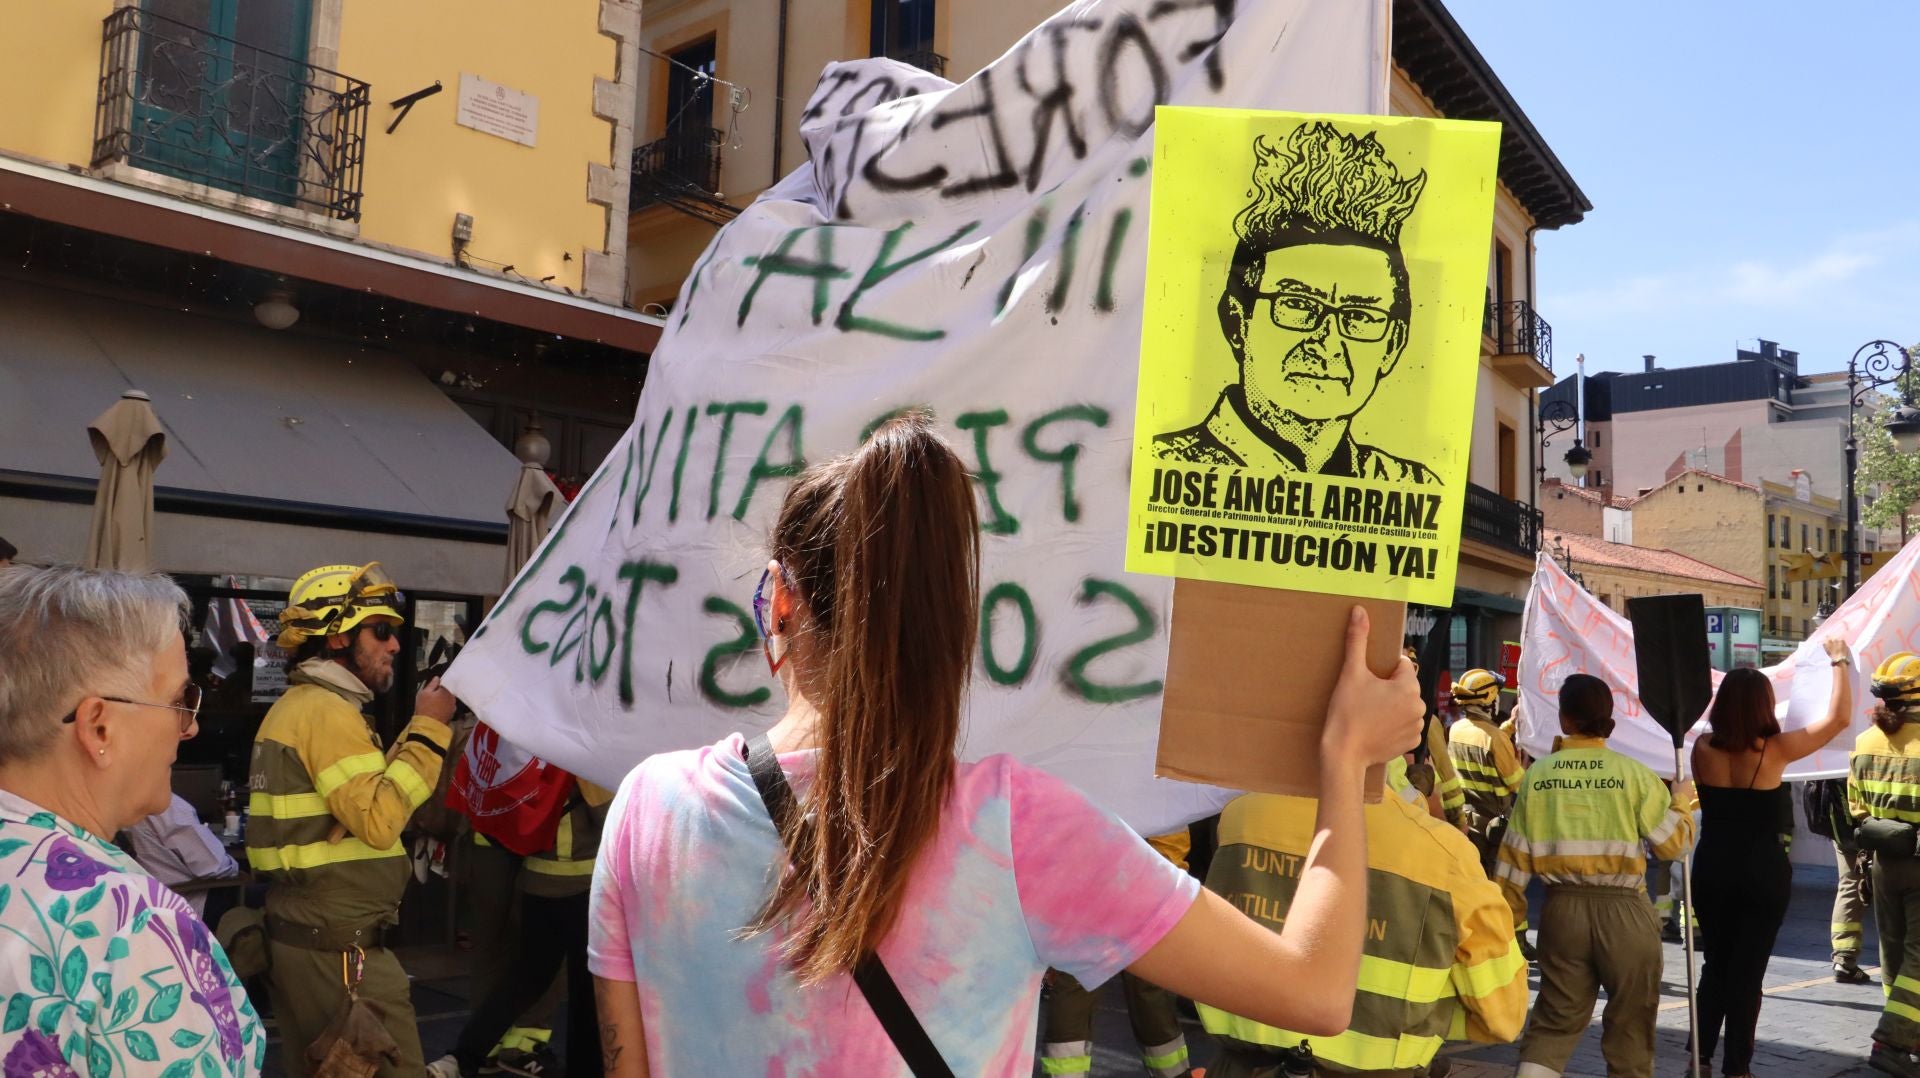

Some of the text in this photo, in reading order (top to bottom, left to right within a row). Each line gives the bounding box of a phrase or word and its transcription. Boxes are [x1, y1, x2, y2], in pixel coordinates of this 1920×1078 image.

[1149, 467, 1442, 531] JOSÉ ÁNGEL ARRANZ
[1147, 503, 1179, 515] Director
[1180, 506, 1210, 518] General
[1211, 509, 1222, 519] de
[1223, 512, 1266, 523] Patrimonio
[1267, 516, 1296, 526] Natural
[1297, 519, 1303, 527] y
[1335, 522, 1367, 533] Forestal
[1368, 526, 1378, 535] de
[1380, 526, 1411, 538] Castilla
[1412, 531, 1417, 539] y
[1144, 521, 1439, 579] ¡DESTITUCIÓN YA!
[1707, 615, 1719, 632] P
[1732, 615, 1738, 633] P
[1553, 760, 1604, 770] JUNTA DE
[1533, 777, 1624, 791] CASTILLA Y LEÓN
[1241, 847, 1303, 879] JUNT
